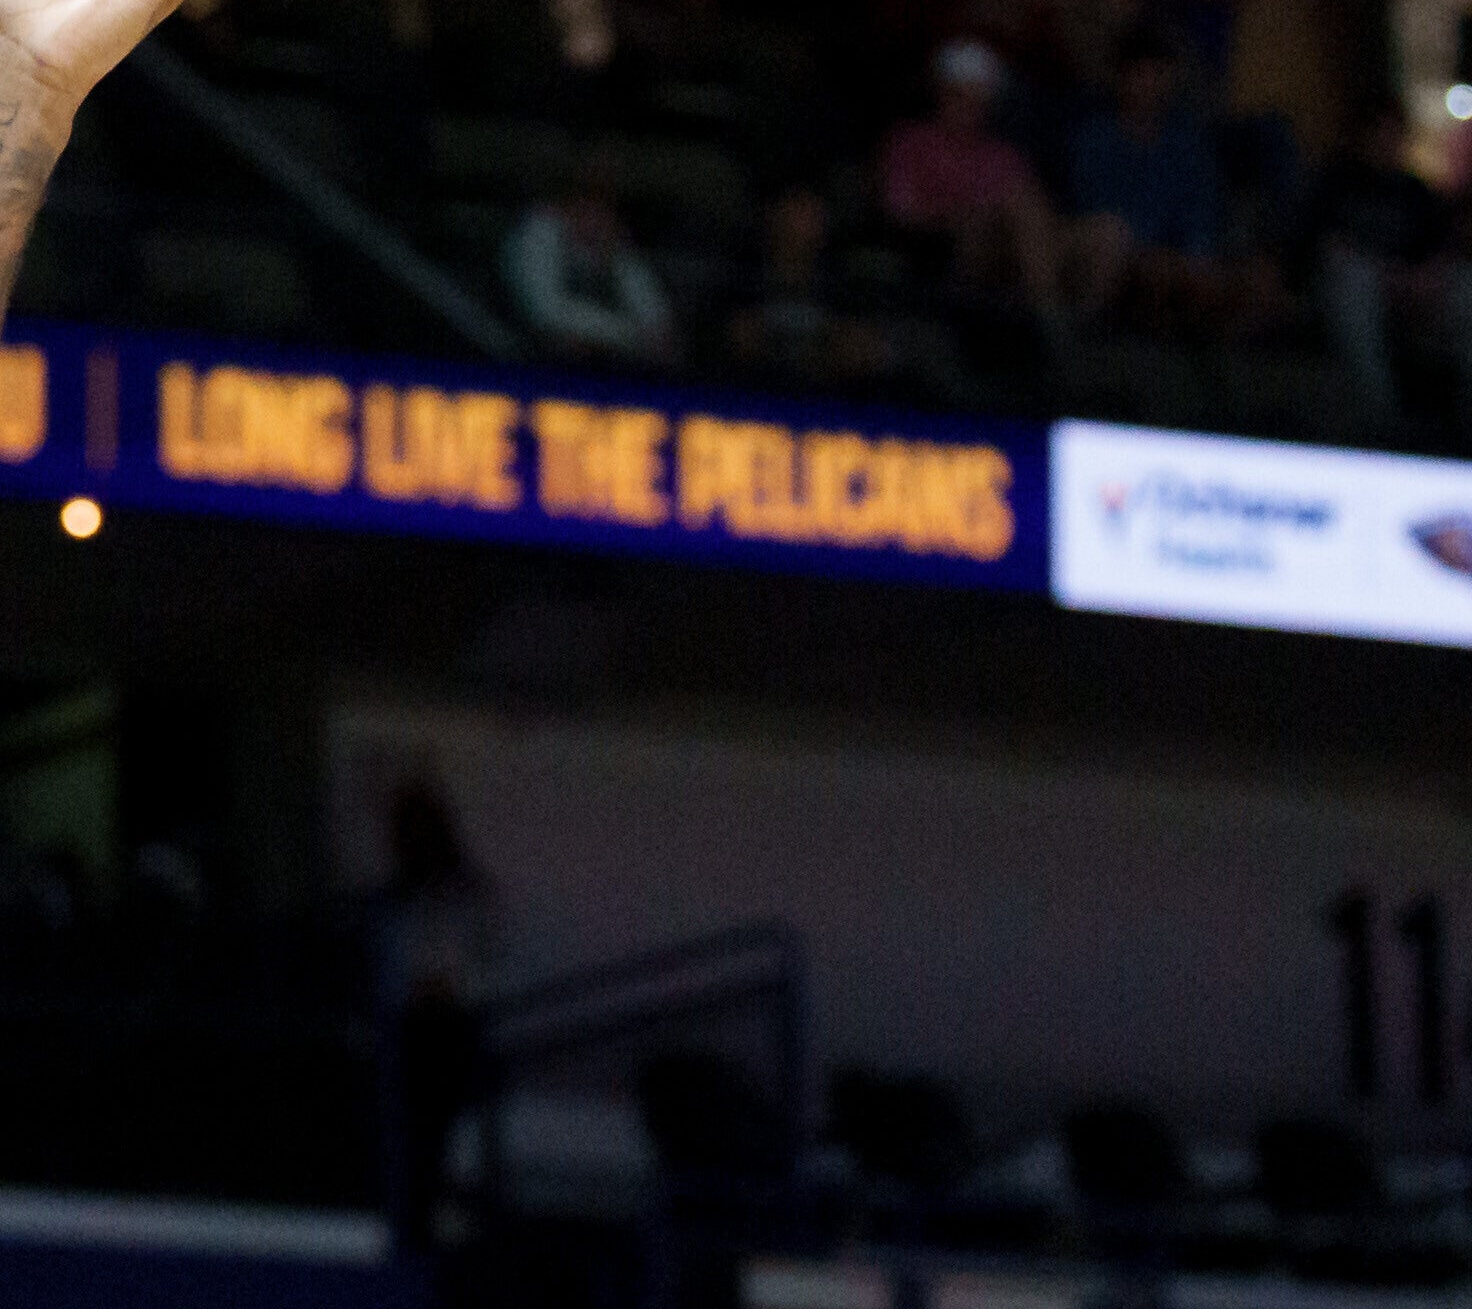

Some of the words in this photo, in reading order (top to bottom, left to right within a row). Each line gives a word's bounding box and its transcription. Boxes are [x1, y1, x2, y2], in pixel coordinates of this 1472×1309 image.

[165, 371, 350, 484] LONG
[367, 393, 512, 500] LIVE
[537, 405, 662, 517] THE
[682, 420, 1007, 553] PELICANS
